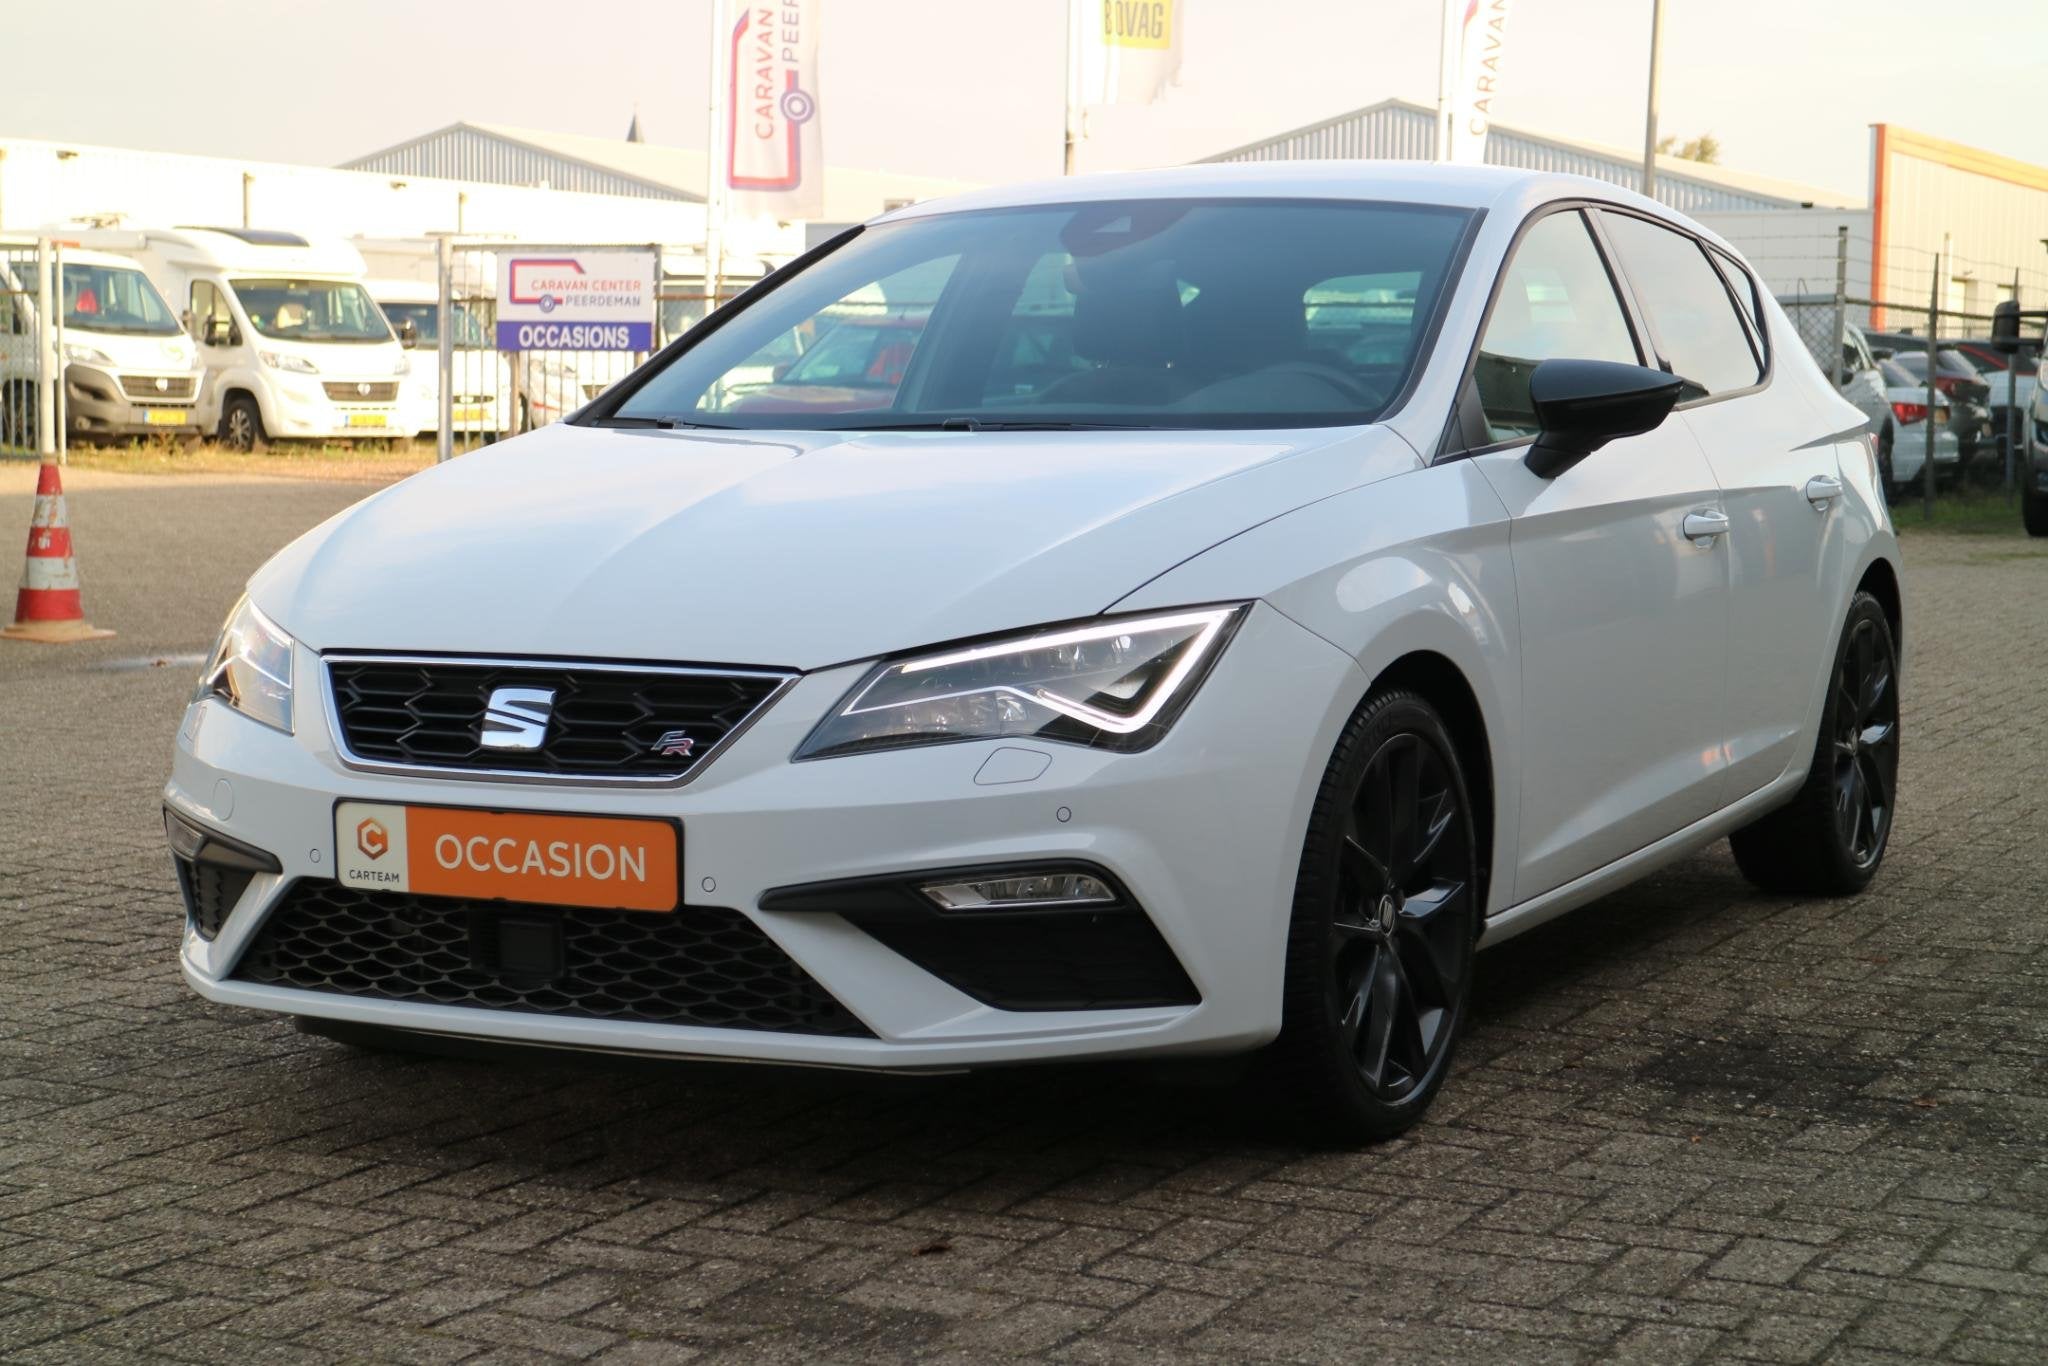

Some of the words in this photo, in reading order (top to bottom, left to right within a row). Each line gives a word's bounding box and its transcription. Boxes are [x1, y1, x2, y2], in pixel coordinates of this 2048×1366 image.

[1104, 0, 1164, 39] BOVAG
[755, 9, 774, 139] CARAVAN
[531, 279, 589, 292] CARAVAN
[592, 279, 641, 292] CENTER
[565, 295, 641, 307] PEERDEMAN
[519, 325, 630, 349] OCCASIONS
[434, 833, 646, 882] OCCASION
[349, 869, 400, 883] CARTEAM
